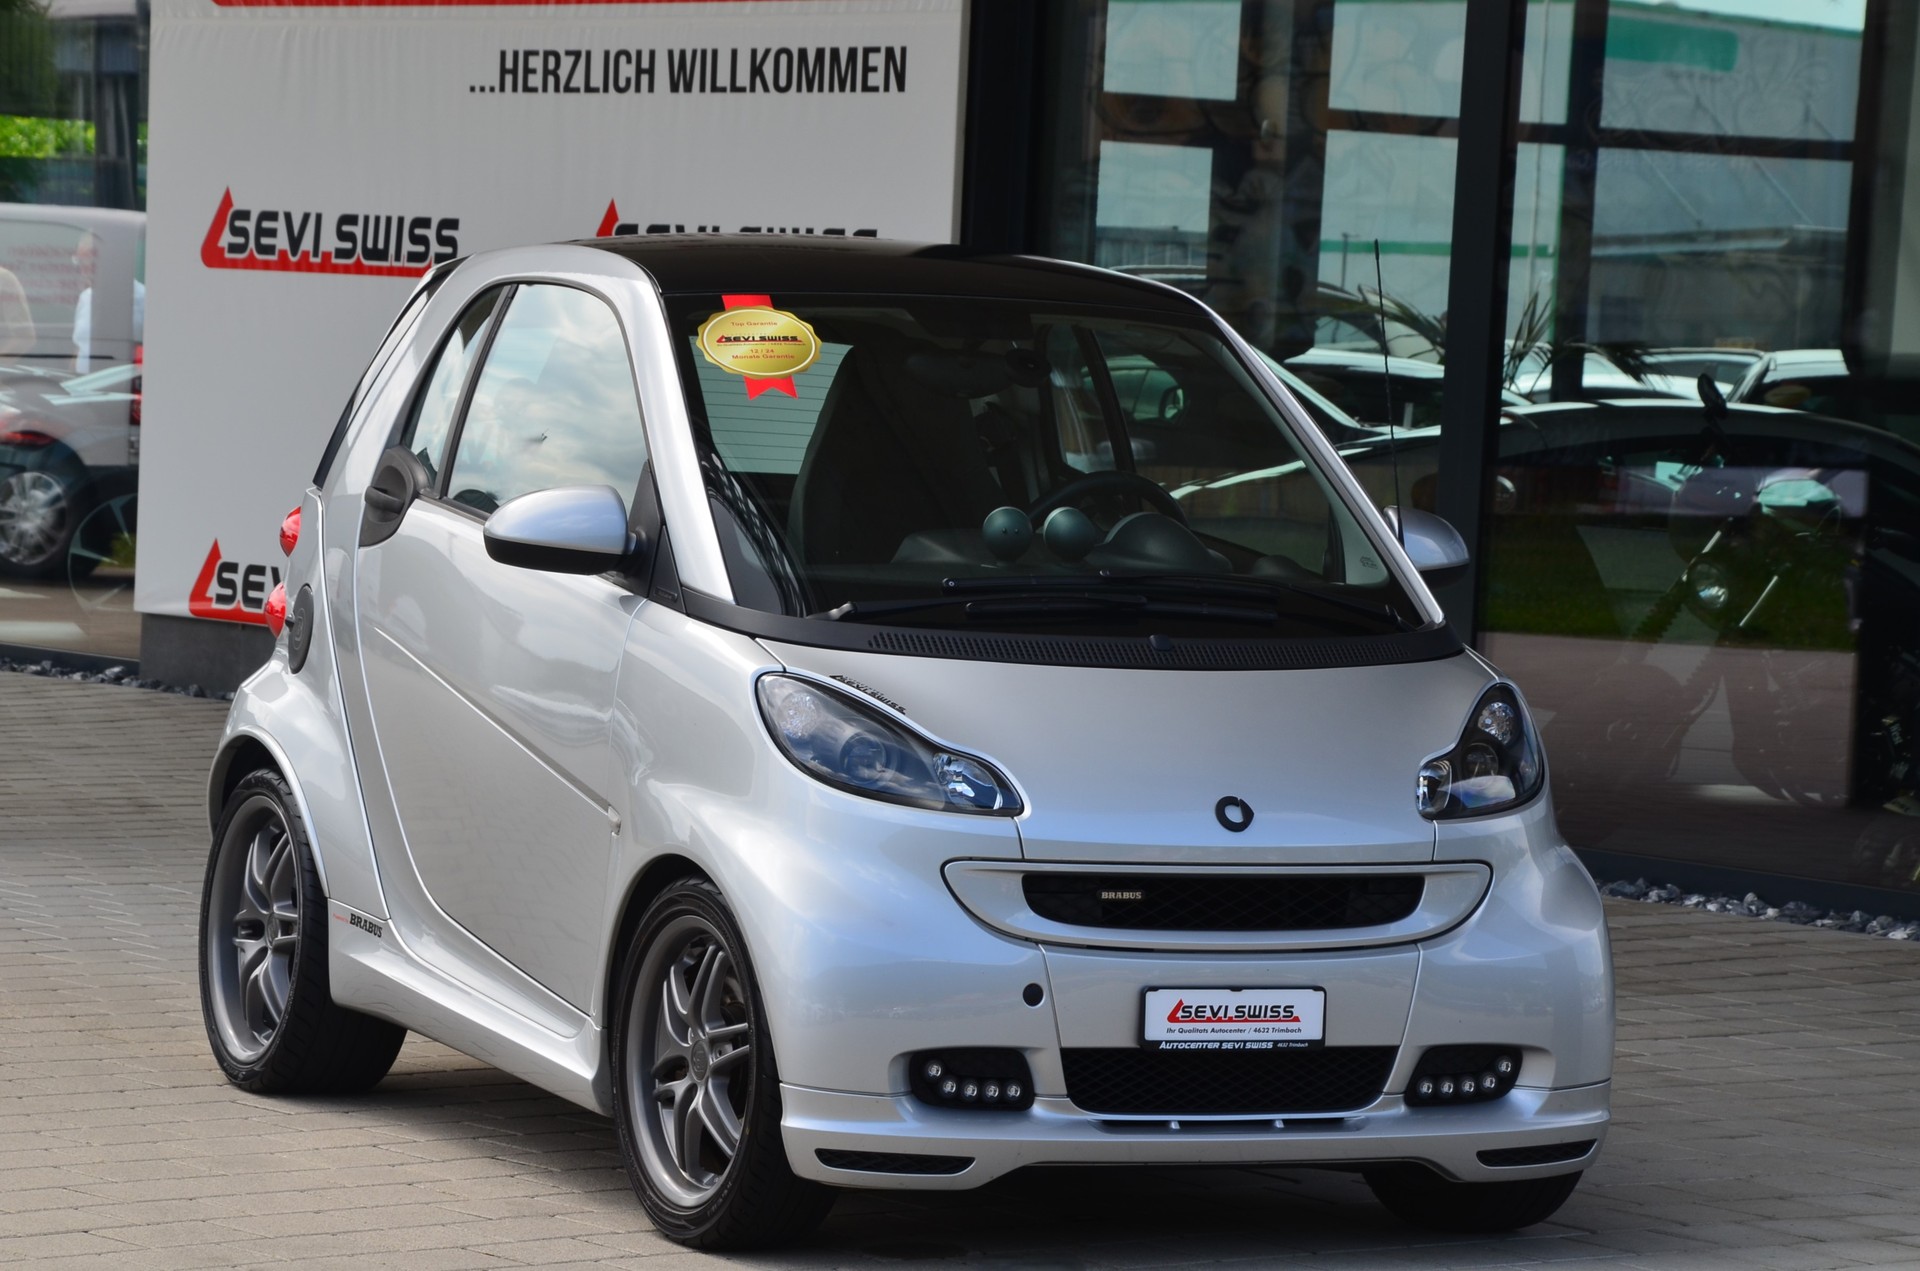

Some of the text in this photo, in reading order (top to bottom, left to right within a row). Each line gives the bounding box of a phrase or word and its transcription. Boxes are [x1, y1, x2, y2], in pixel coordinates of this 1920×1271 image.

[469, 45, 907, 94] ...HERZLICH WILLKOMMEN
[226, 209, 460, 264] SEVI SWISS
[1101, 891, 1142, 899] BRABUS
[349, 912, 383, 938] BRABUS
[1180, 1005, 1295, 1019] SEVI SWISS
[1221, 1041, 1244, 1050] SEVI
[1245, 1041, 1274, 1049] SWISS
